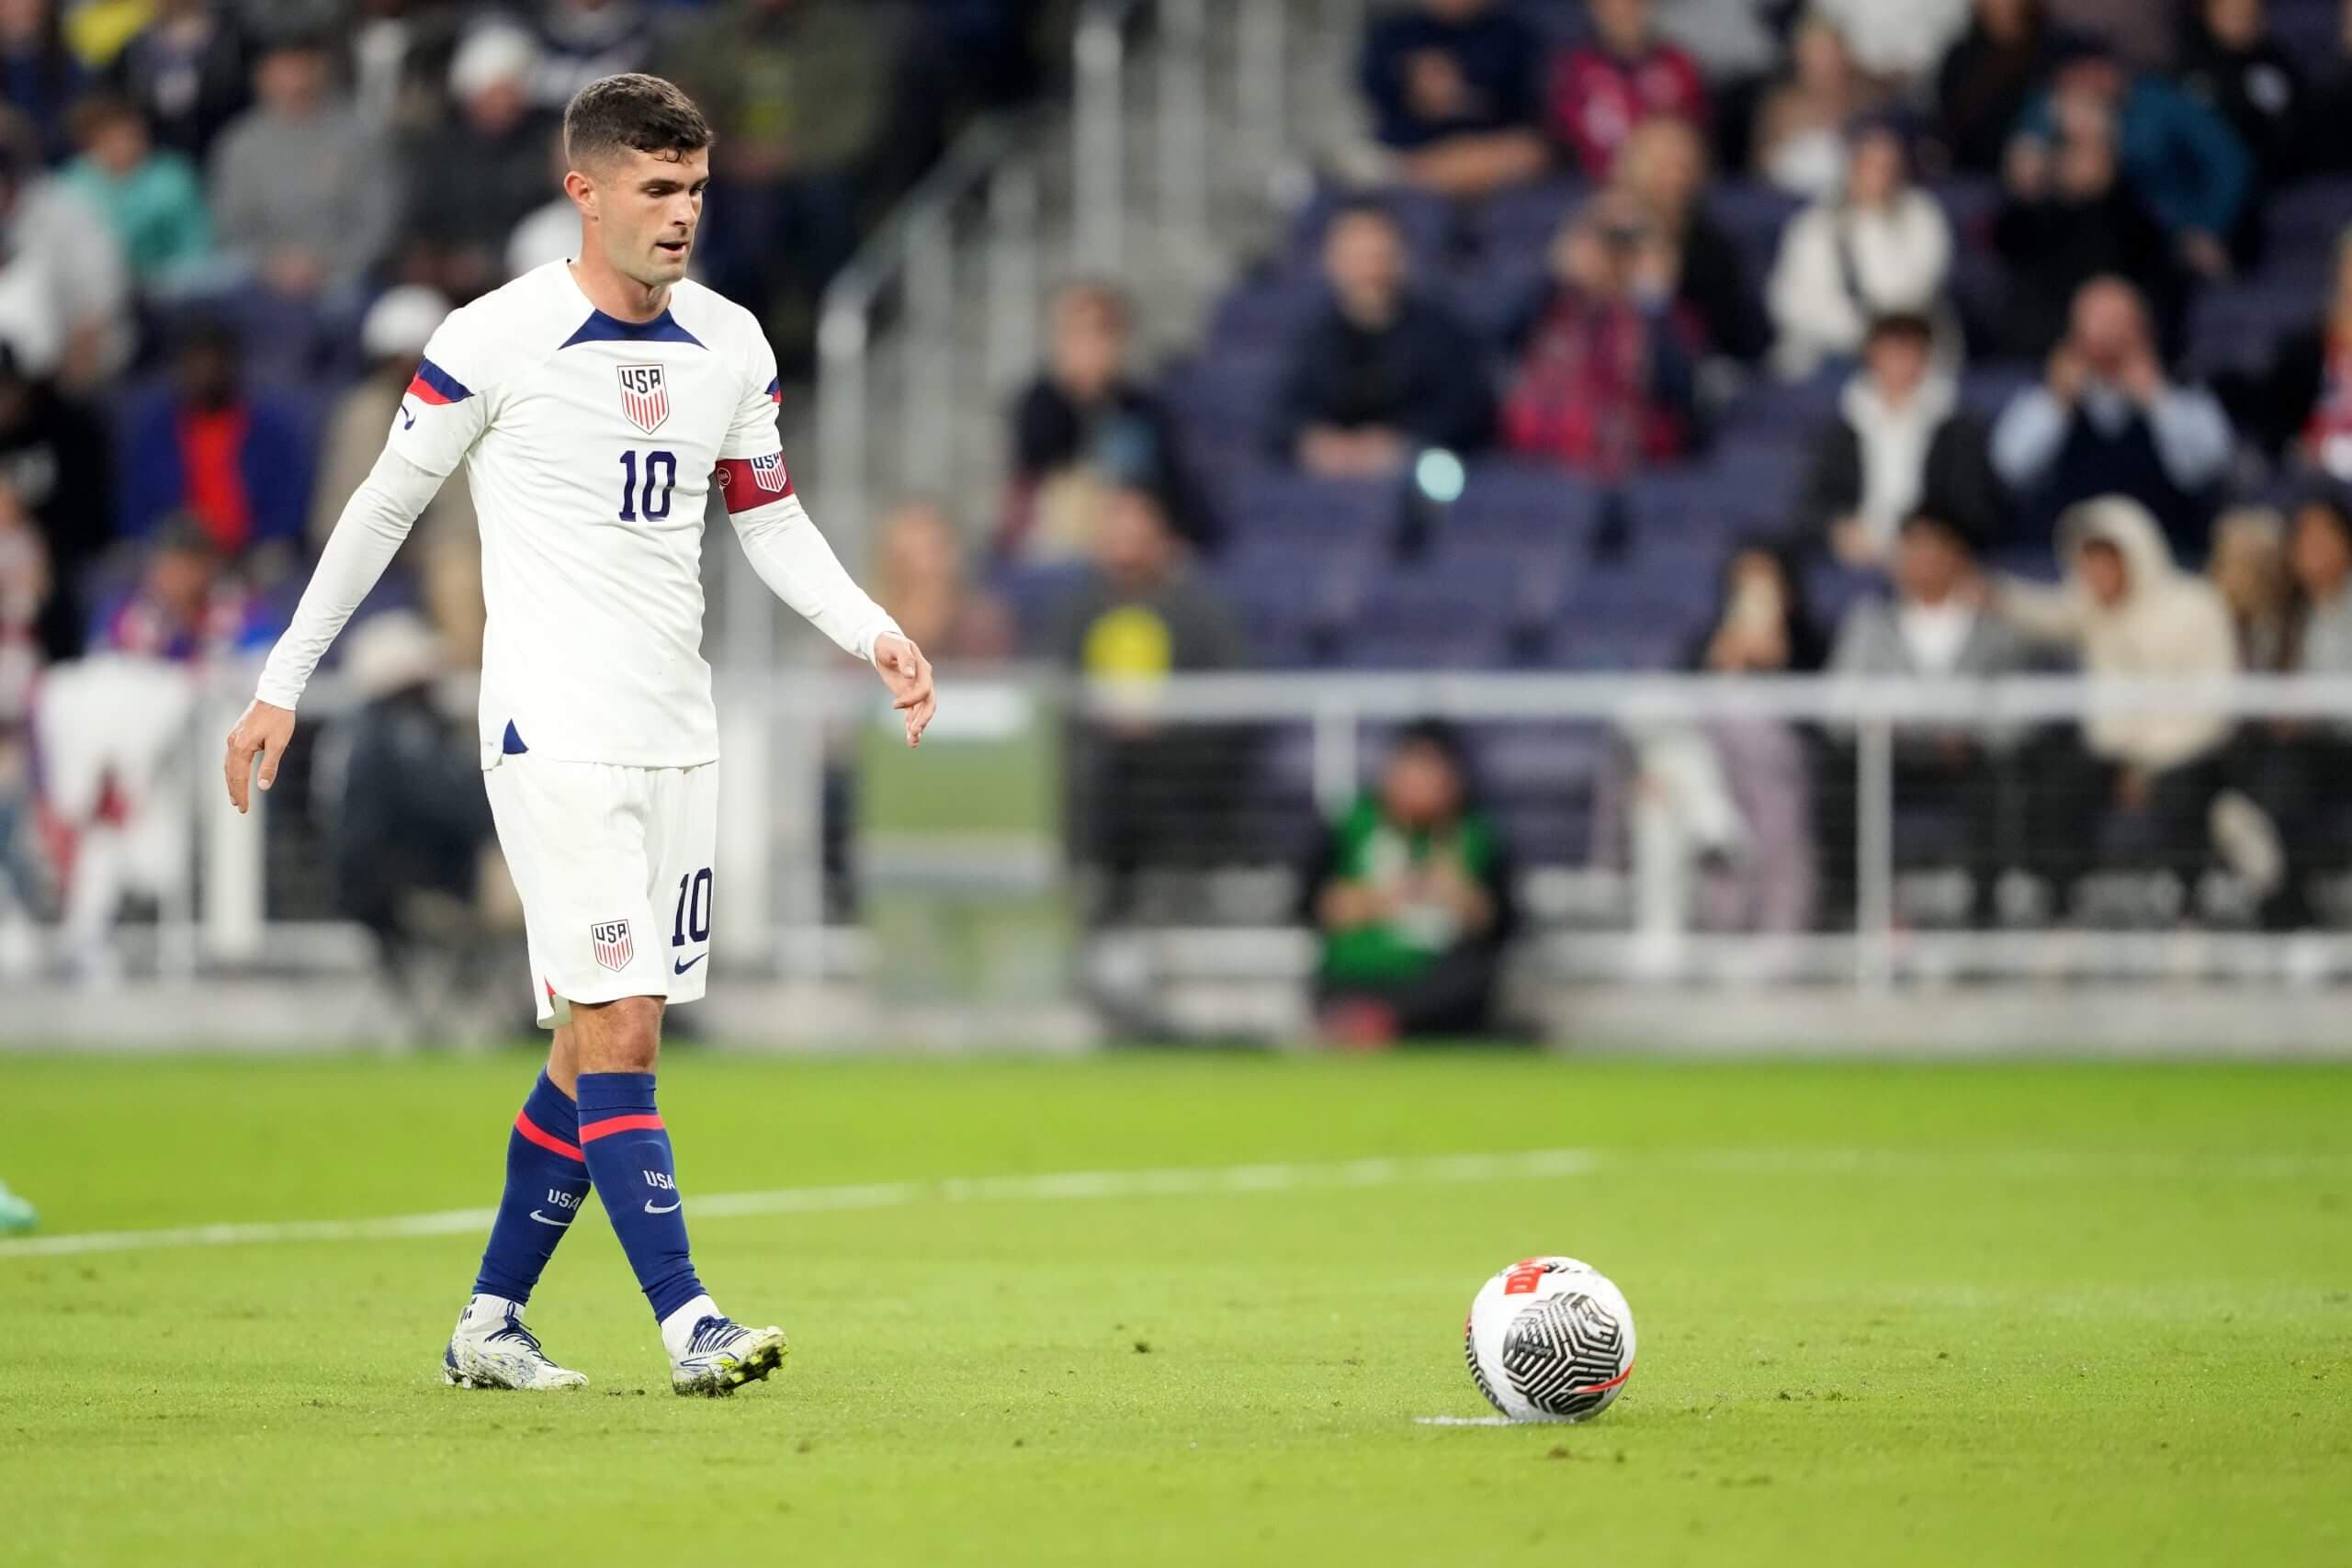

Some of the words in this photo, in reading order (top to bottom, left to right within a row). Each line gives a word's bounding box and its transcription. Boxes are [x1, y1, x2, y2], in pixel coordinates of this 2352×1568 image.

[621, 368, 662, 394] USA
[618, 450, 677, 522] 10
[672, 867, 713, 947] 10
[594, 922, 628, 943] USA
[643, 1169, 675, 1190] USA
[547, 1189, 582, 1211] USA
